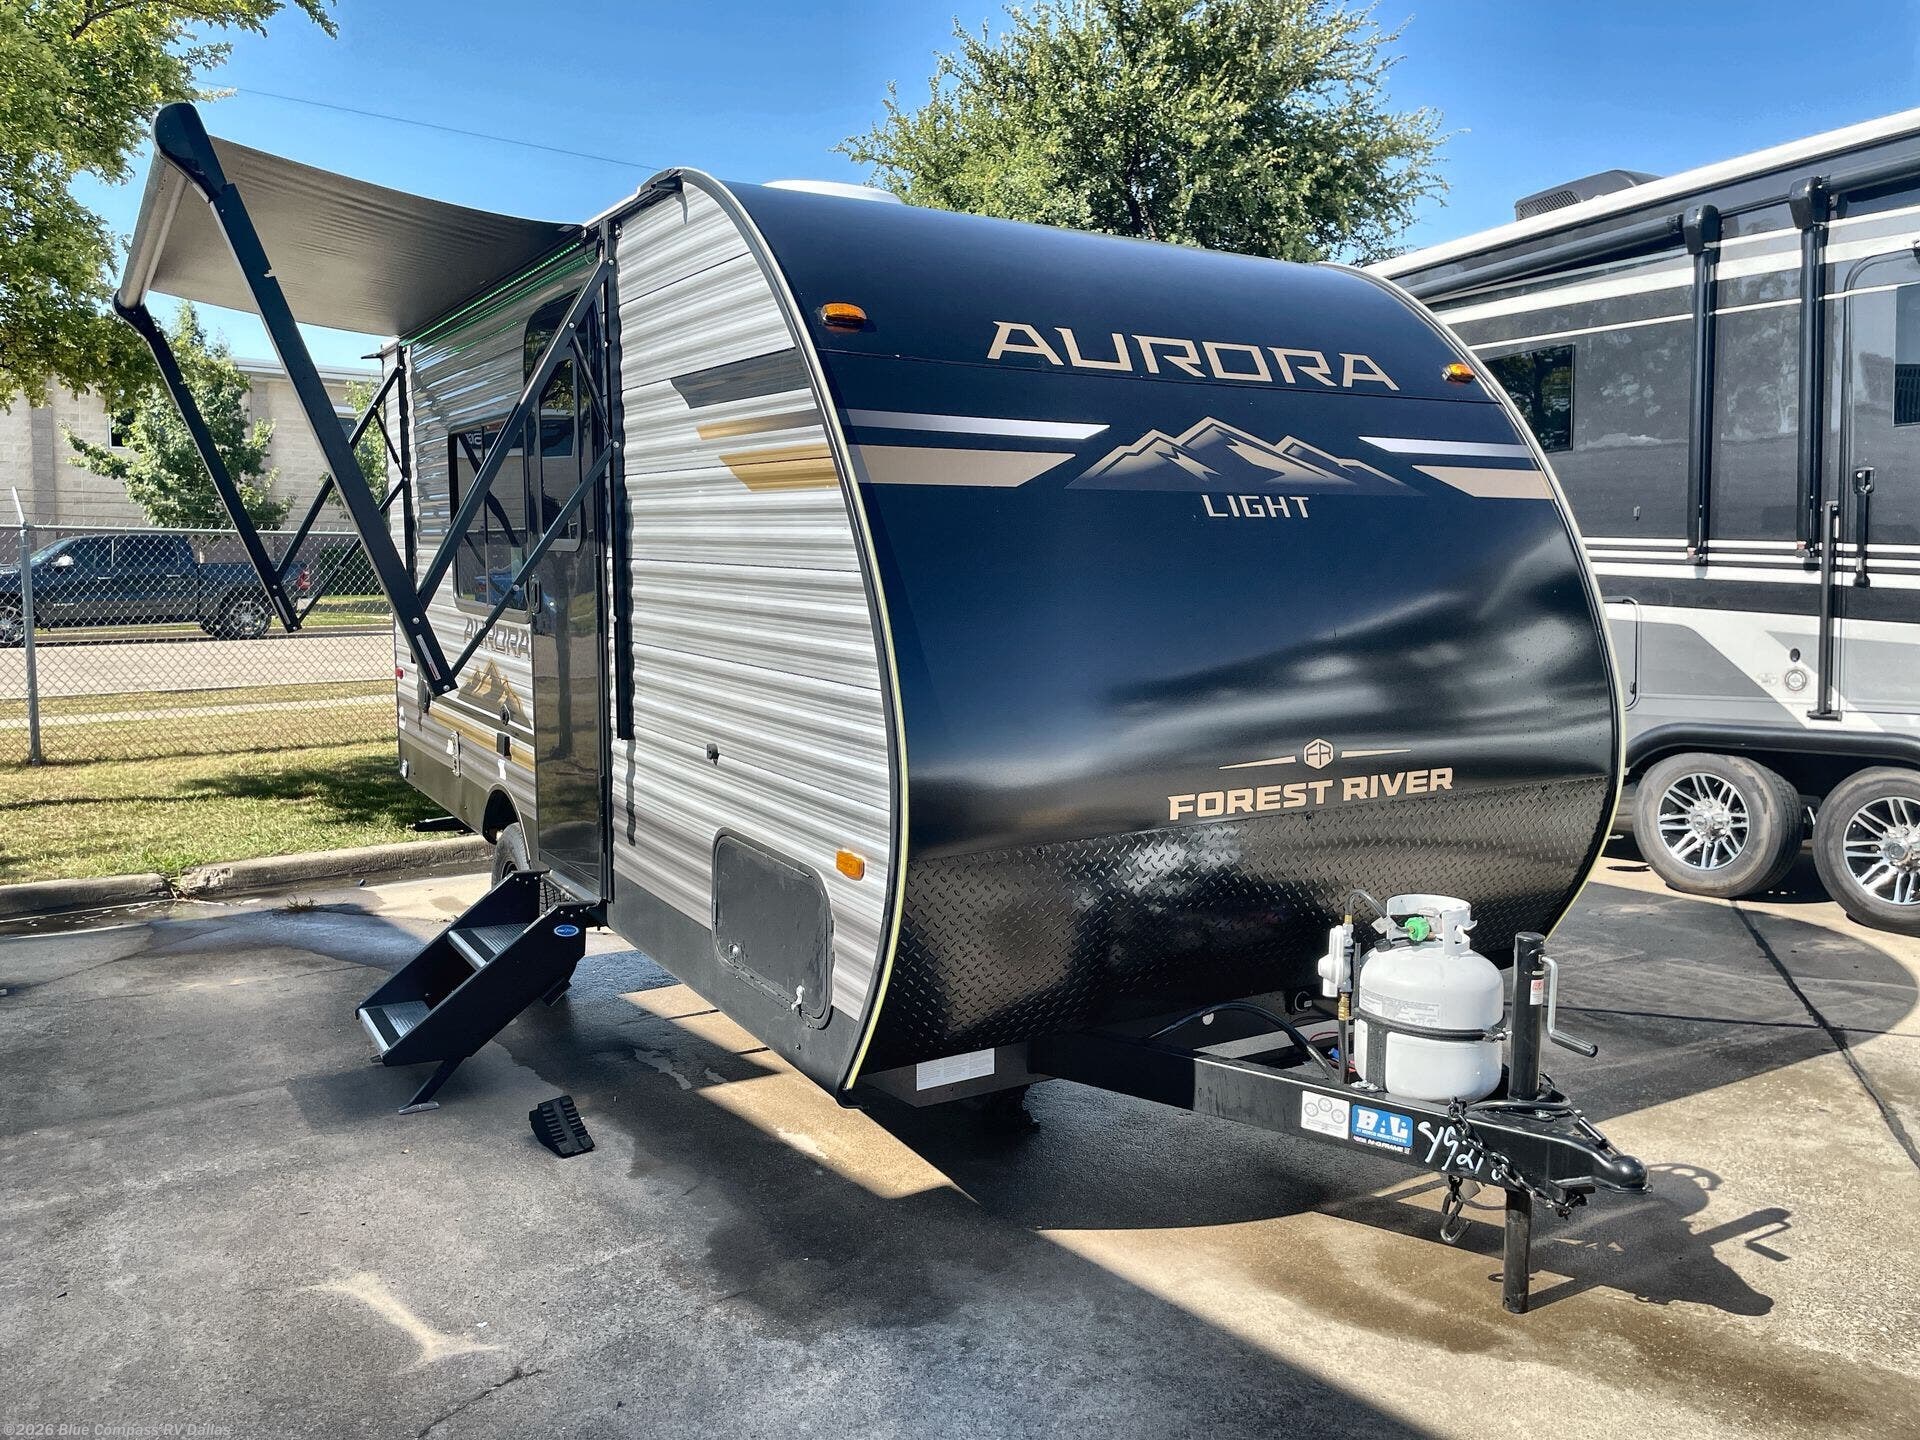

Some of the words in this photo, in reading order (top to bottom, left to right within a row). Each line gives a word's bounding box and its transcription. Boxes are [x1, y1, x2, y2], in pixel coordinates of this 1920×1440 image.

[987, 320, 1400, 391] AURORA
[1201, 494, 1310, 519] LIGHT
[1168, 779, 1333, 821] FOREST
[1341, 767, 1453, 802] RIVER
